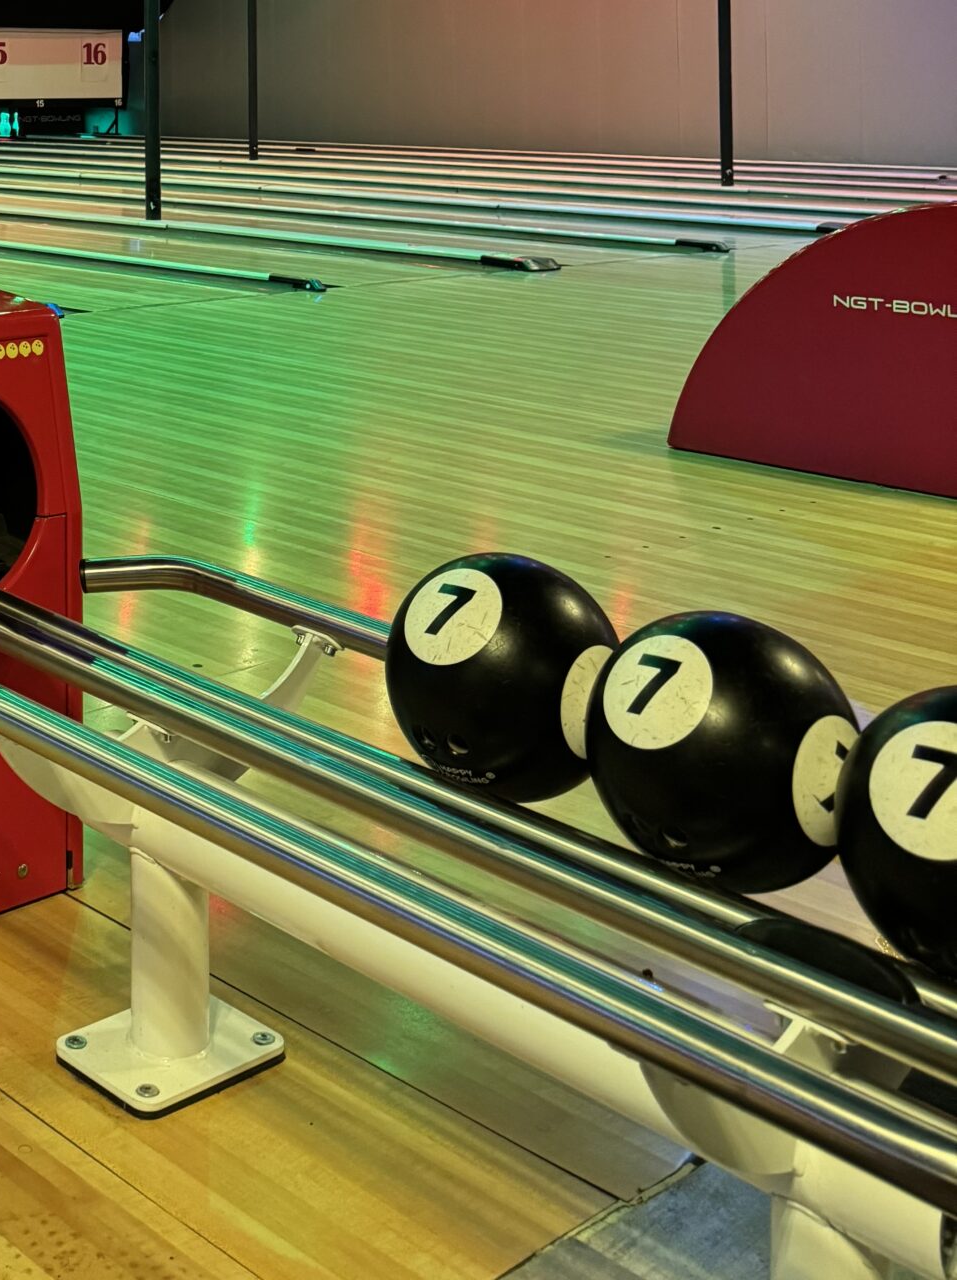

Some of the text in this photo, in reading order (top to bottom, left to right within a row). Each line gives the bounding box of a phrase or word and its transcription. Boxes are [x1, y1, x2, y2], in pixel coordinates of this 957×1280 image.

[82, 42, 107, 66] 16
[35, 99, 45, 108] 15
[833, 294, 957, 318] NGT-BOWL
[423, 582, 477, 636] 7
[626, 653, 684, 716] 7
[906, 743, 957, 821] 7
